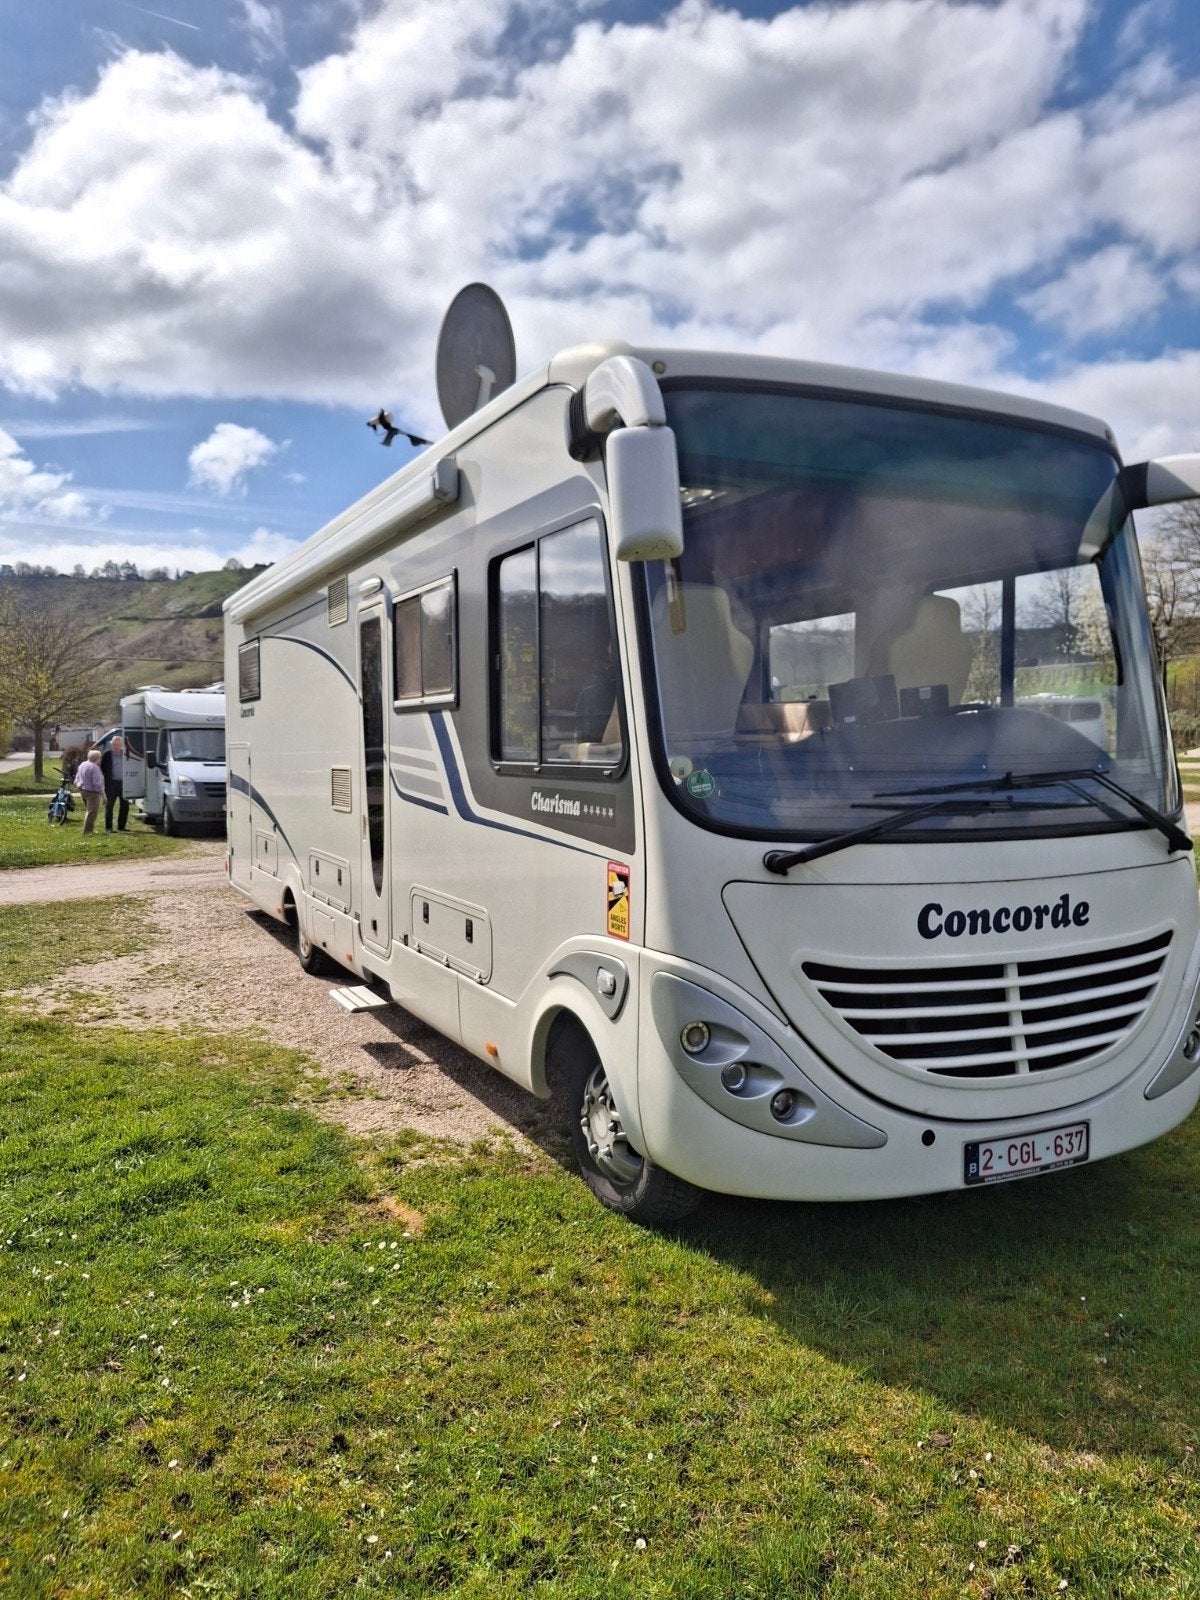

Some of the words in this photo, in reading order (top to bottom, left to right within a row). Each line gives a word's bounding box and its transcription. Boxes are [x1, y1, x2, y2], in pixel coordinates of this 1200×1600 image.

[531, 791, 580, 816] Charisma
[917, 893, 1090, 940] Concorde
[969, 1162, 977, 1174] B
